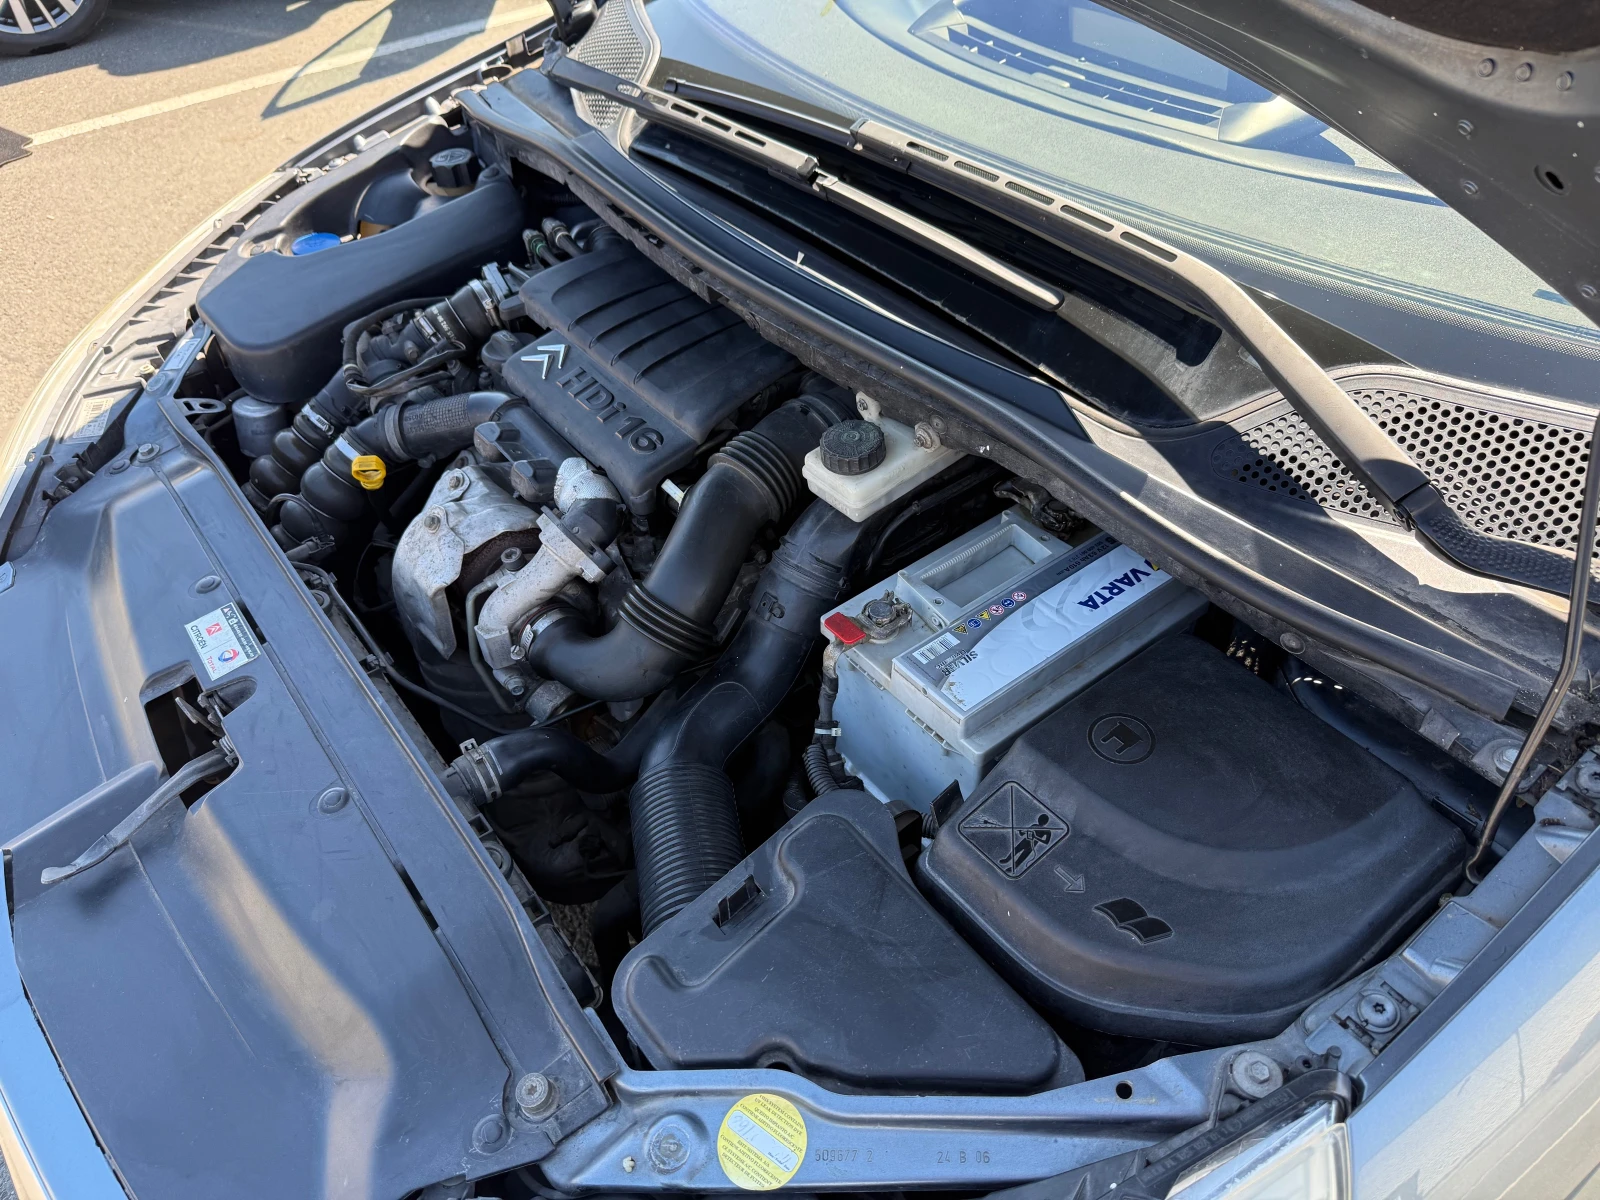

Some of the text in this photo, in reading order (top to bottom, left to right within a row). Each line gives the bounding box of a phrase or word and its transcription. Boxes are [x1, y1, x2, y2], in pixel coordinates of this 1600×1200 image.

[556, 366, 664, 454] HDi 16
[1077, 568, 1151, 610] VARTA
[941, 651, 978, 677] SILVER
[739, 1103, 759, 1119] CONTIENE
[753, 1106, 769, 1120] QUESTO
[768, 1117, 788, 1134] IMPIANTO
[760, 1102, 771, 1112] LEAK
[770, 1110, 794, 1129] DETECTION
[793, 1127, 802, 1135] DYE
[768, 1100, 784, 1114] SYSTEM
[783, 1112, 804, 1129] CONTAINS
[719, 1134, 739, 1150] CONTIENE
[737, 1140, 747, 1149] ESTE
[746, 1147, 762, 1161] SISTEMA
[721, 1152, 744, 1172] DETECTEUR
[749, 1174, 765, 1188] FUITES
[937, 1151, 990, 1164] 24 B 06
[751, 1167, 772, 1186] CONTIENT
